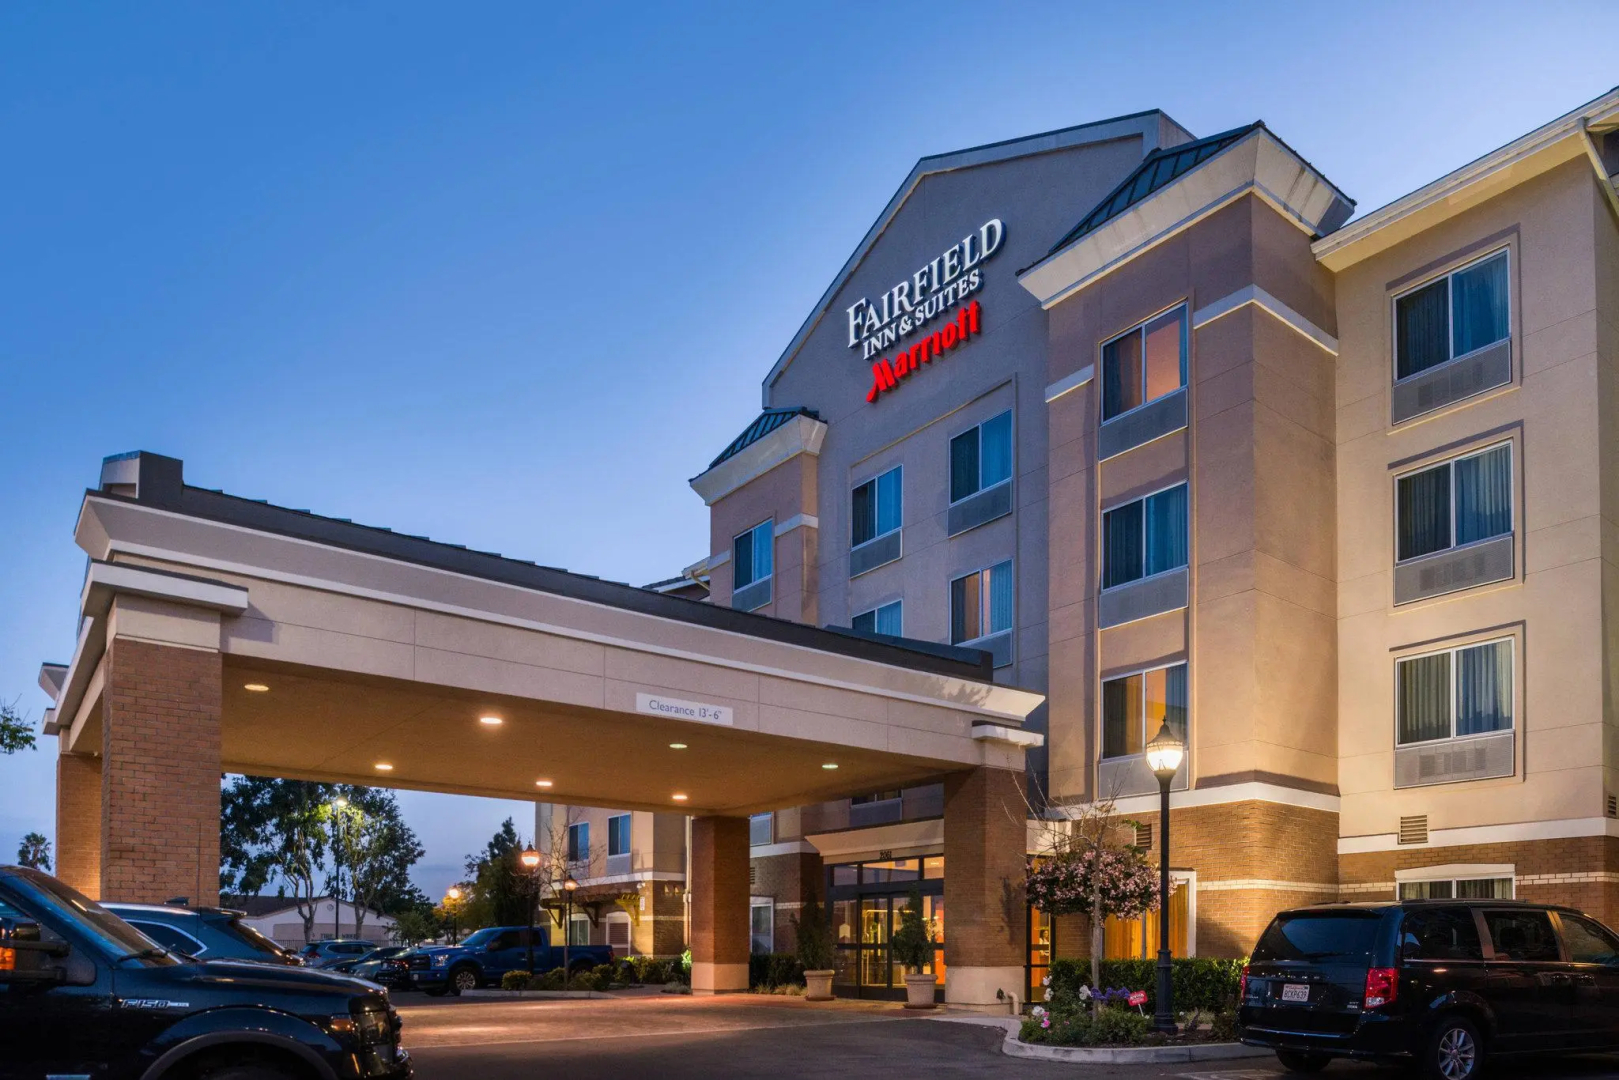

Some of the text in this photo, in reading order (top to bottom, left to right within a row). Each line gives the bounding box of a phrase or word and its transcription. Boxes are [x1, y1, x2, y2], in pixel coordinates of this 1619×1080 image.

[846, 218, 1004, 348] FAIRFIELD
[863, 268, 981, 360] INN & SUITES
[866, 299, 982, 403] Marriott
[648, 699, 695, 717] Clearance
